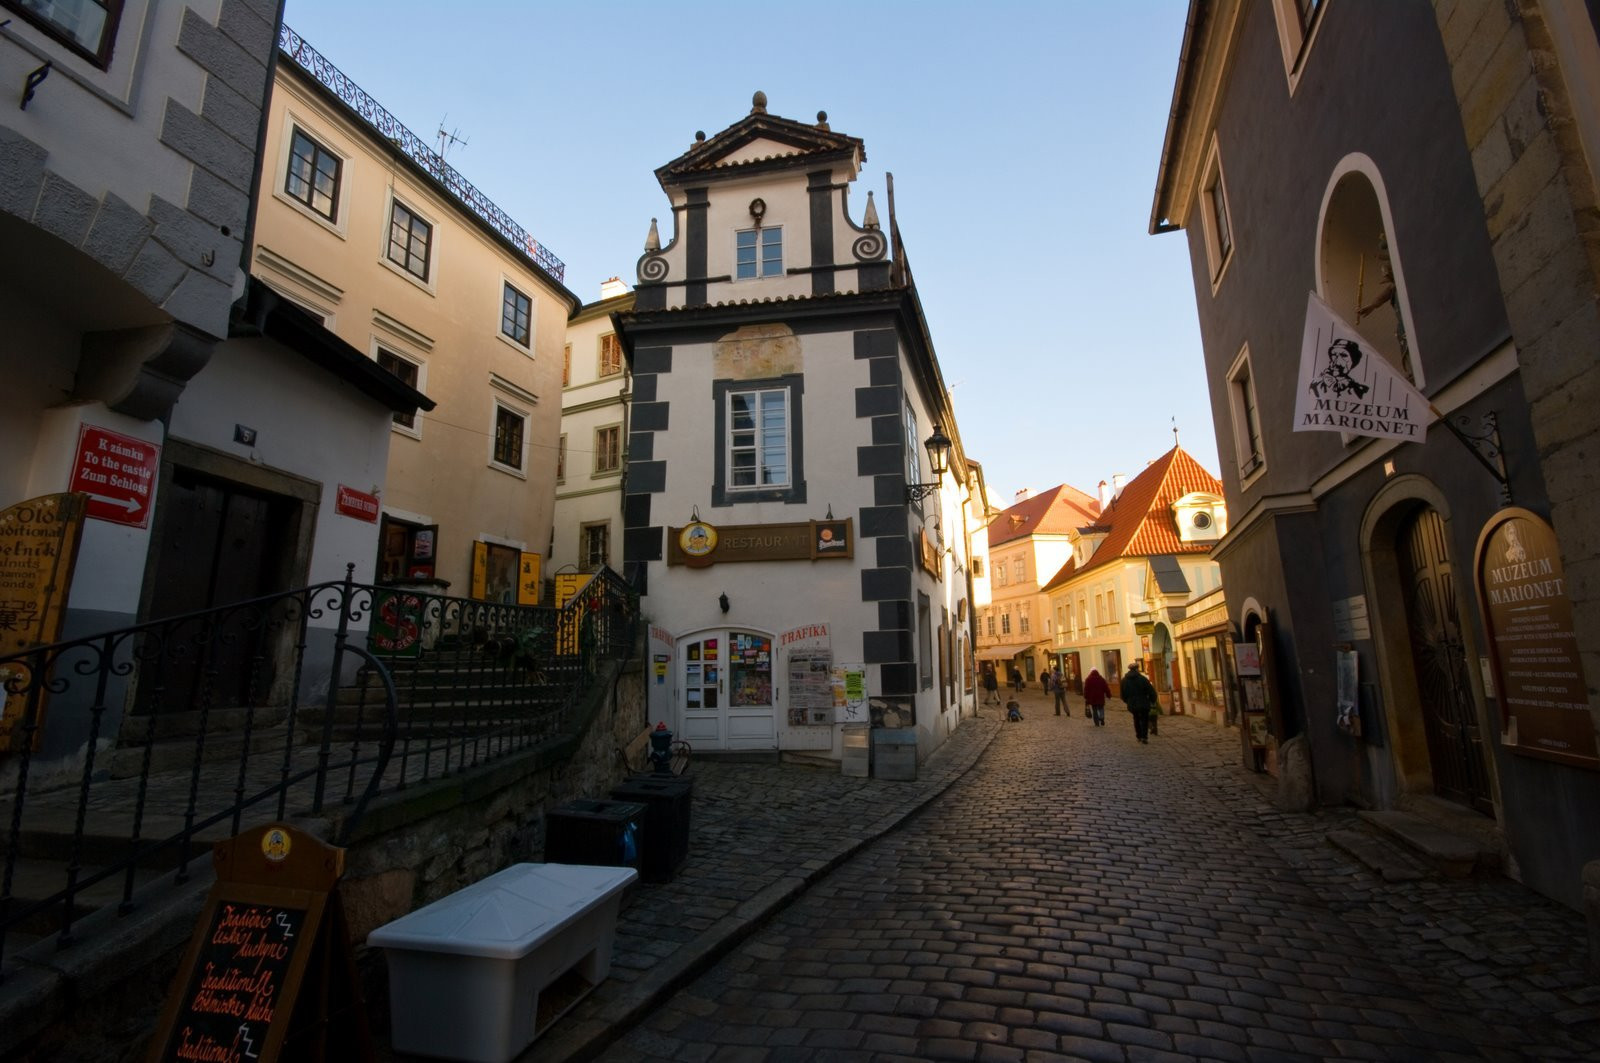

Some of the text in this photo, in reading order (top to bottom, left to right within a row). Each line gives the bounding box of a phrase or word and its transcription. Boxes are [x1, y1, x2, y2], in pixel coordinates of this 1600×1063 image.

[1314, 399, 1409, 419] MUZEUM
[1303, 413, 1419, 436] MARIONET
[98, 438, 144, 461] K zámku
[84, 451, 151, 479] To the castle
[80, 467, 148, 495] Zum Schloss
[16, 507, 55, 524] Old
[1491, 557, 1553, 585] MUZEUM
[1490, 578, 1564, 605] MARIONET
[781, 624, 828, 646] TRAFIKA
